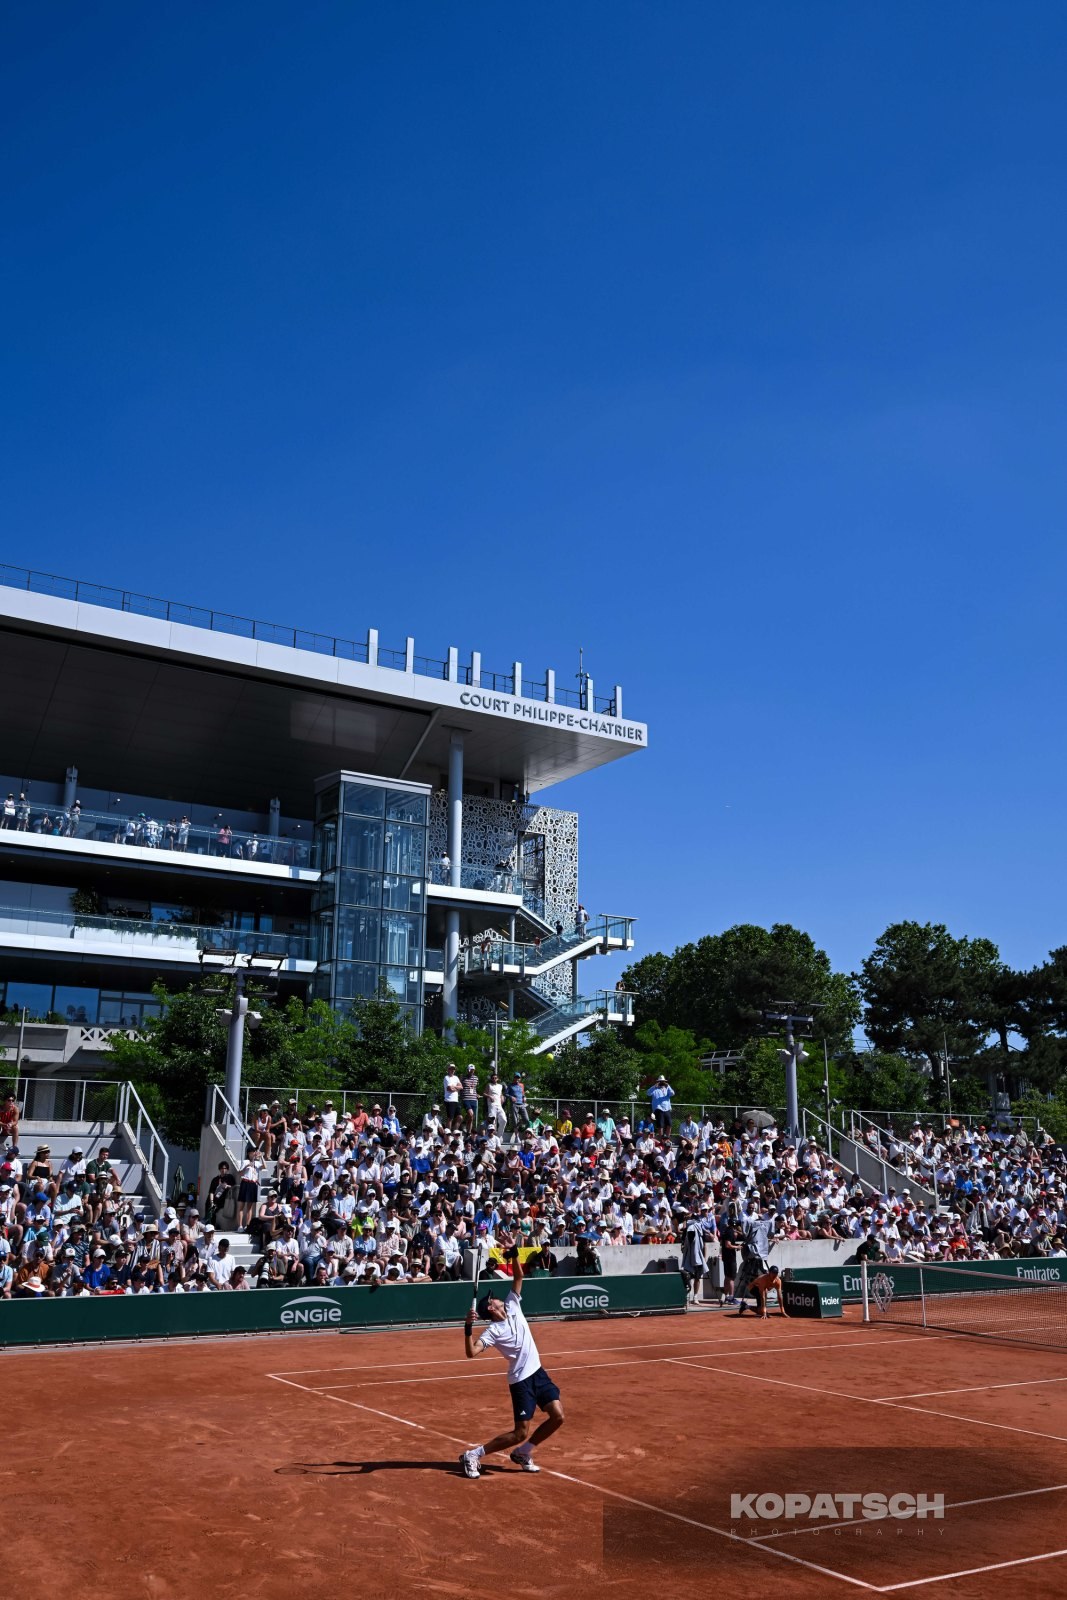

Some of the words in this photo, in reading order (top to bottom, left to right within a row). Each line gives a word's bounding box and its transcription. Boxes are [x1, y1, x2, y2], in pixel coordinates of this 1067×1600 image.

[460, 692, 510, 713] COURT
[513, 703, 643, 742] PHILIPPE-CHATRIER
[1016, 1265, 1060, 1281] Emirates
[842, 1274, 895, 1292] Emras
[787, 1292, 815, 1307] Haier
[821, 1296, 840, 1306] Haier
